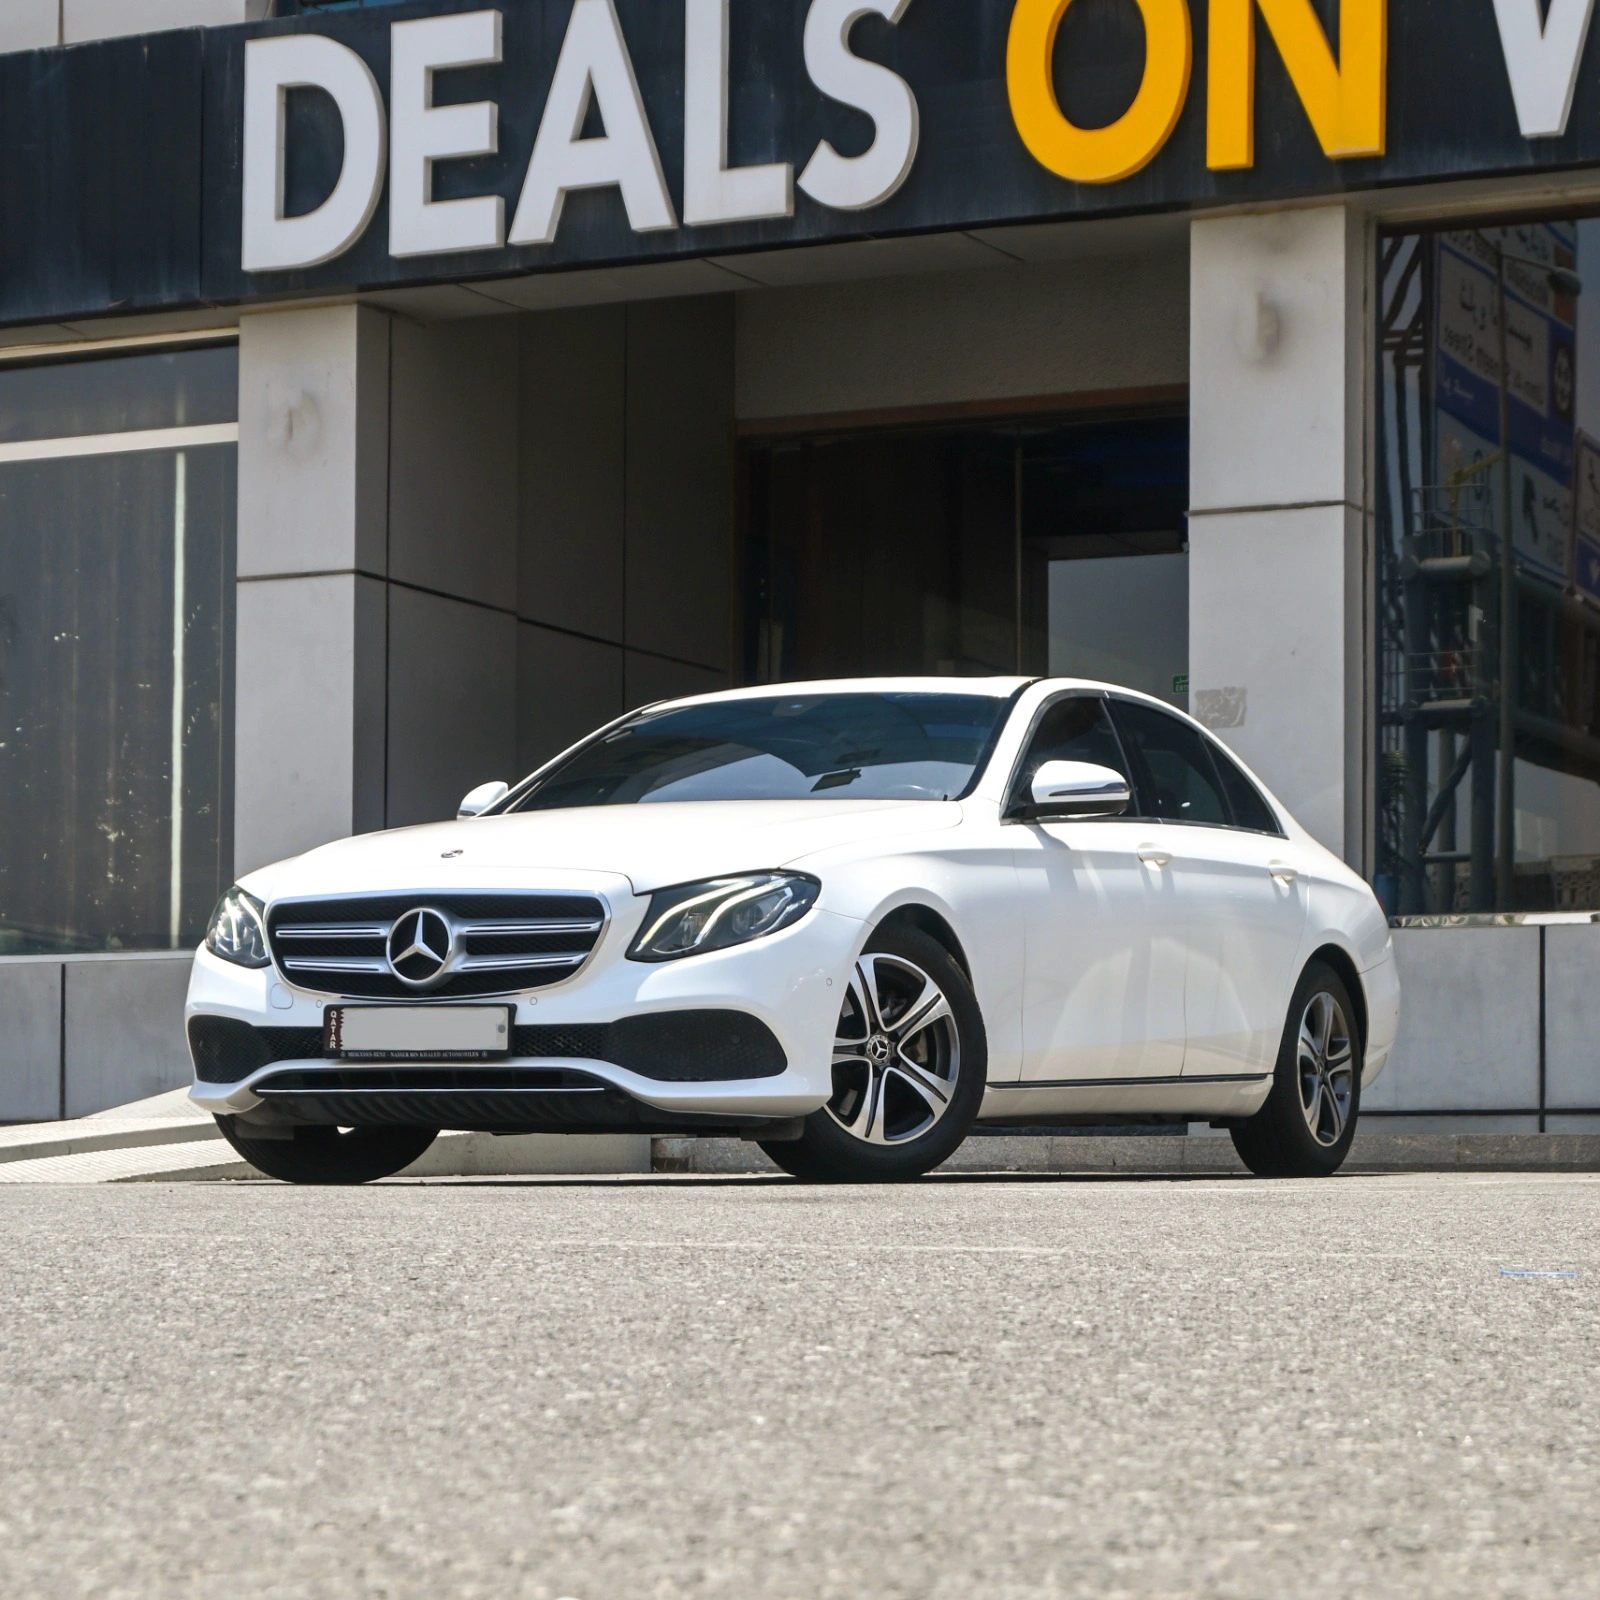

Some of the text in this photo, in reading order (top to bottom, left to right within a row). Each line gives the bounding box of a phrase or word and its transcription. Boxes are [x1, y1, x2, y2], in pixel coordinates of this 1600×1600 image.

[241, 0, 919, 273] DEALS
[1006, 0, 1387, 184] ON
[329, 1010, 337, 1049] QATAR
